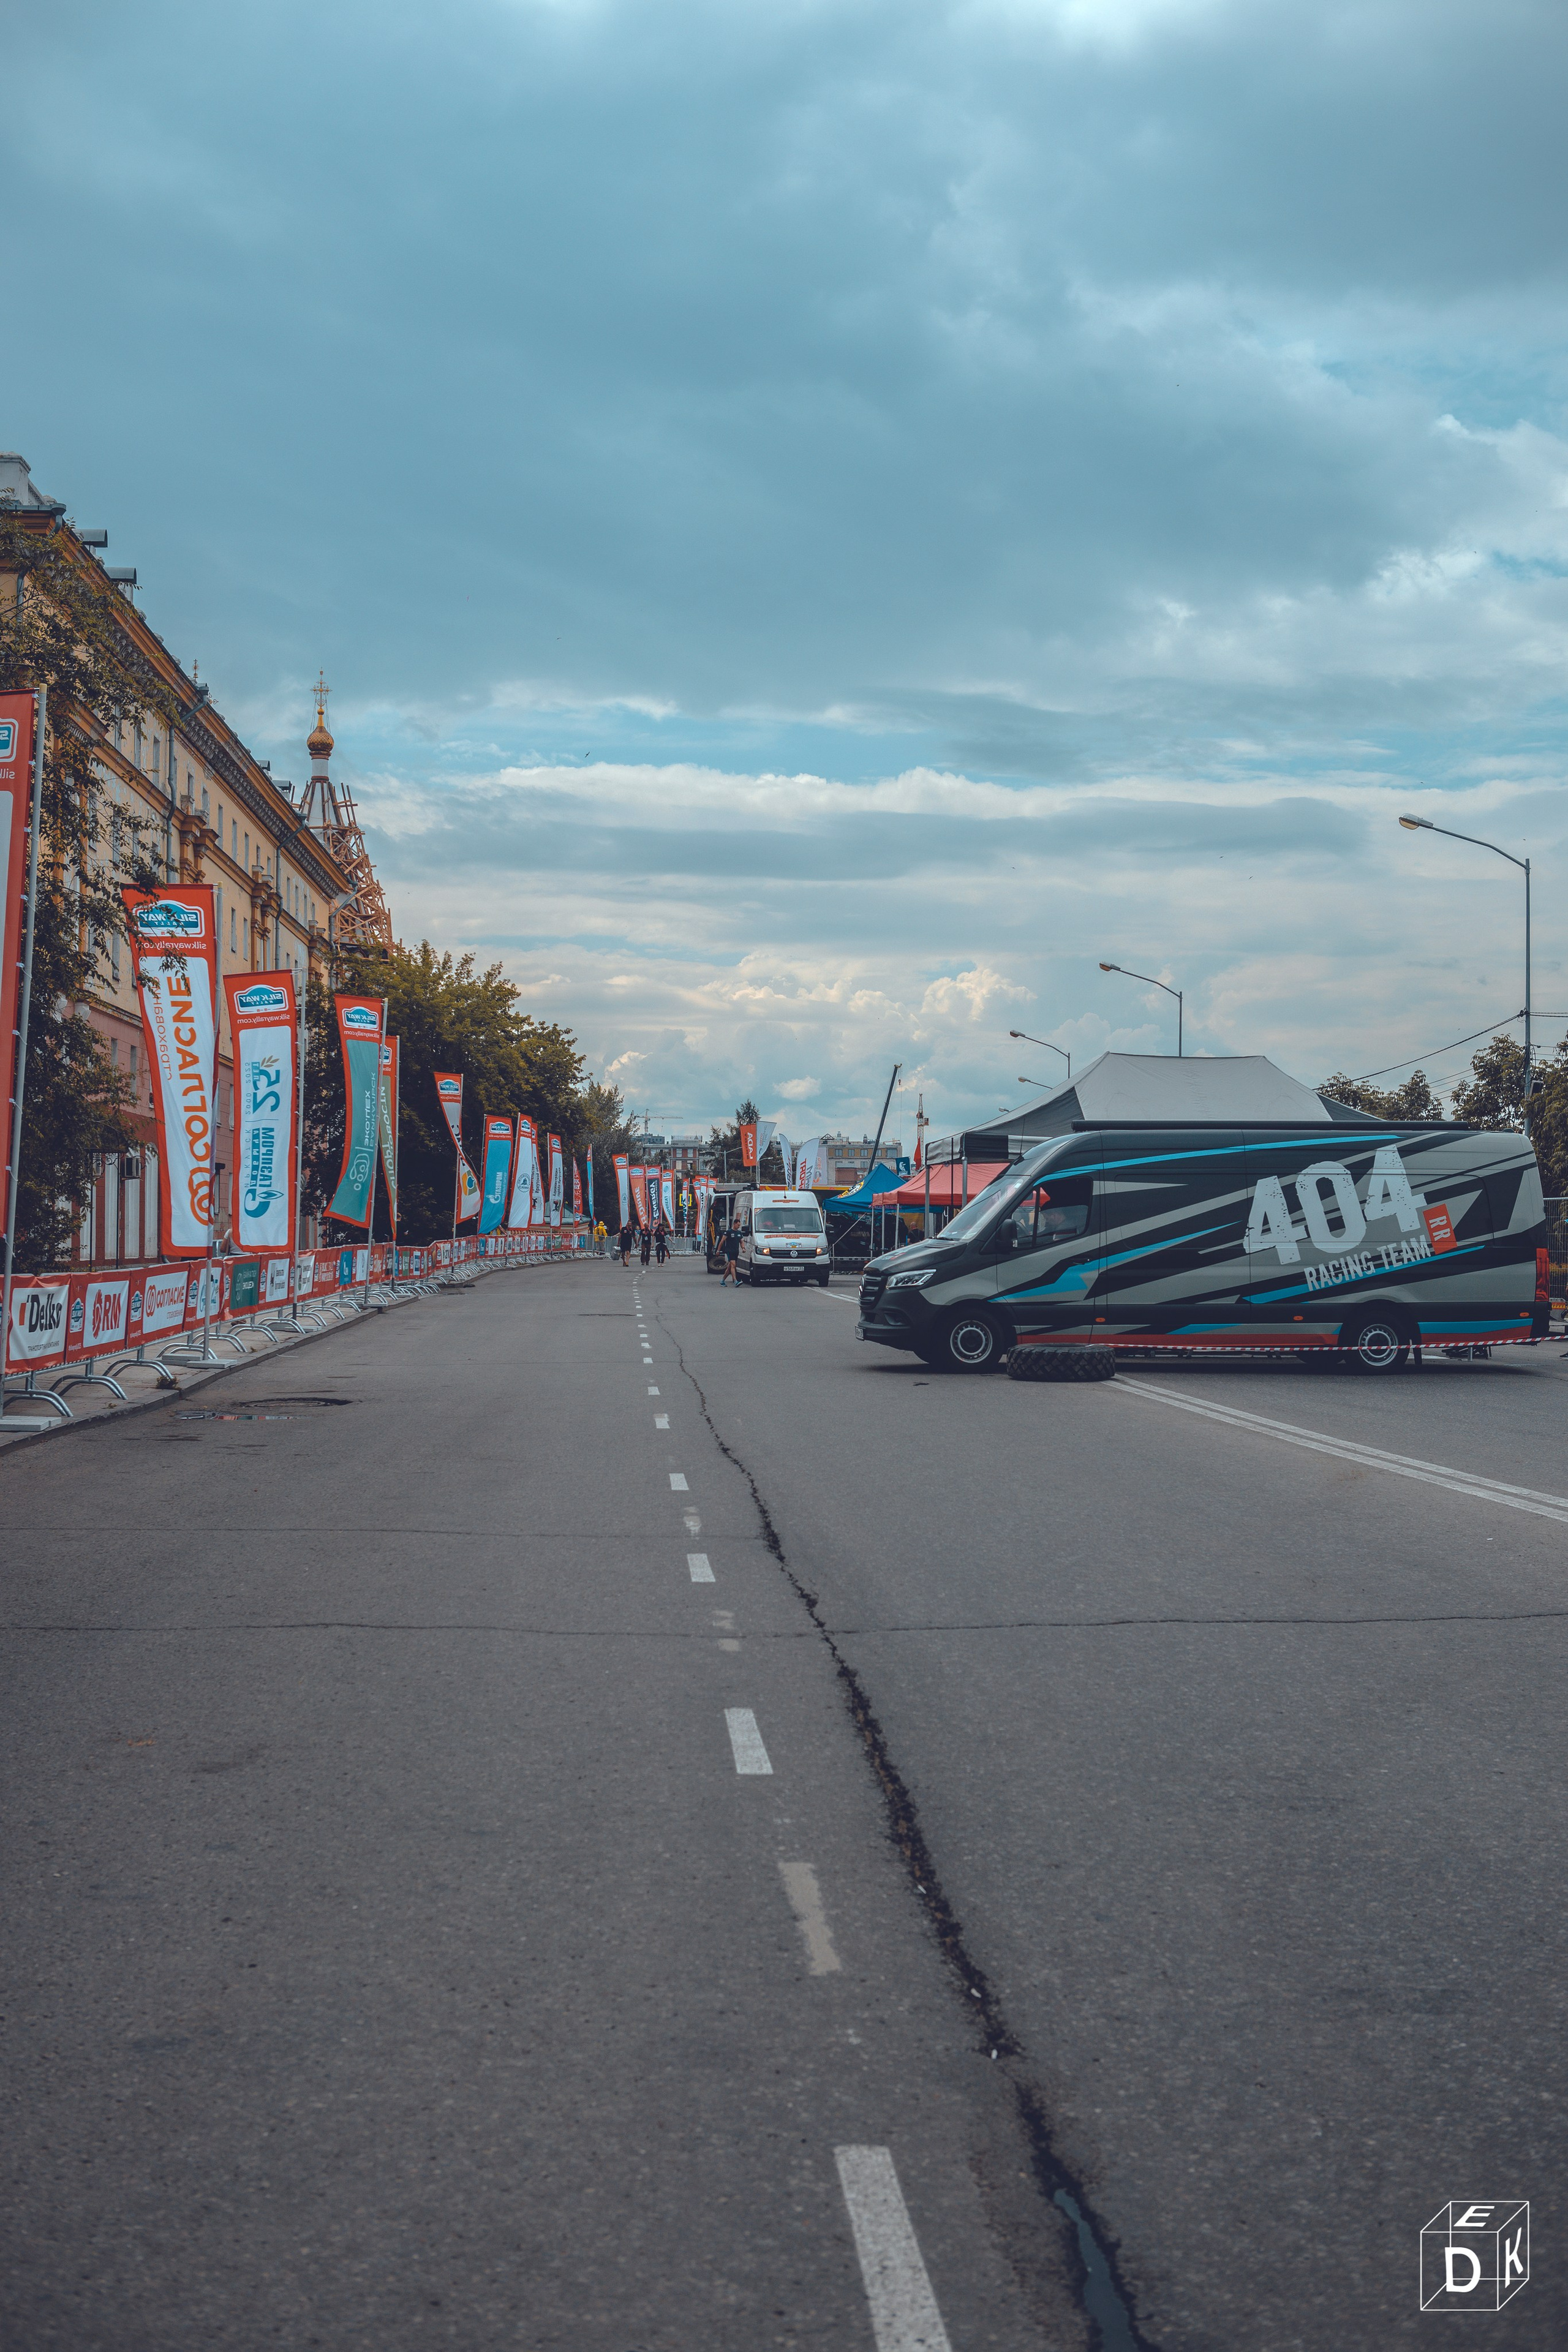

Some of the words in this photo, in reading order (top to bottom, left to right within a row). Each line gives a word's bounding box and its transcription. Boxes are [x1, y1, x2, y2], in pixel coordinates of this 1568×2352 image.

[1243, 1144, 1428, 1265] 404
[1429, 1215, 1451, 1242] RR
[1304, 1251, 1376, 1292] RACING
[1377, 1234, 1431, 1270] TEAM
[29, 1294, 62, 1333] Delko
[156, 1285, 184, 1308] СОГЛАСИЕ
